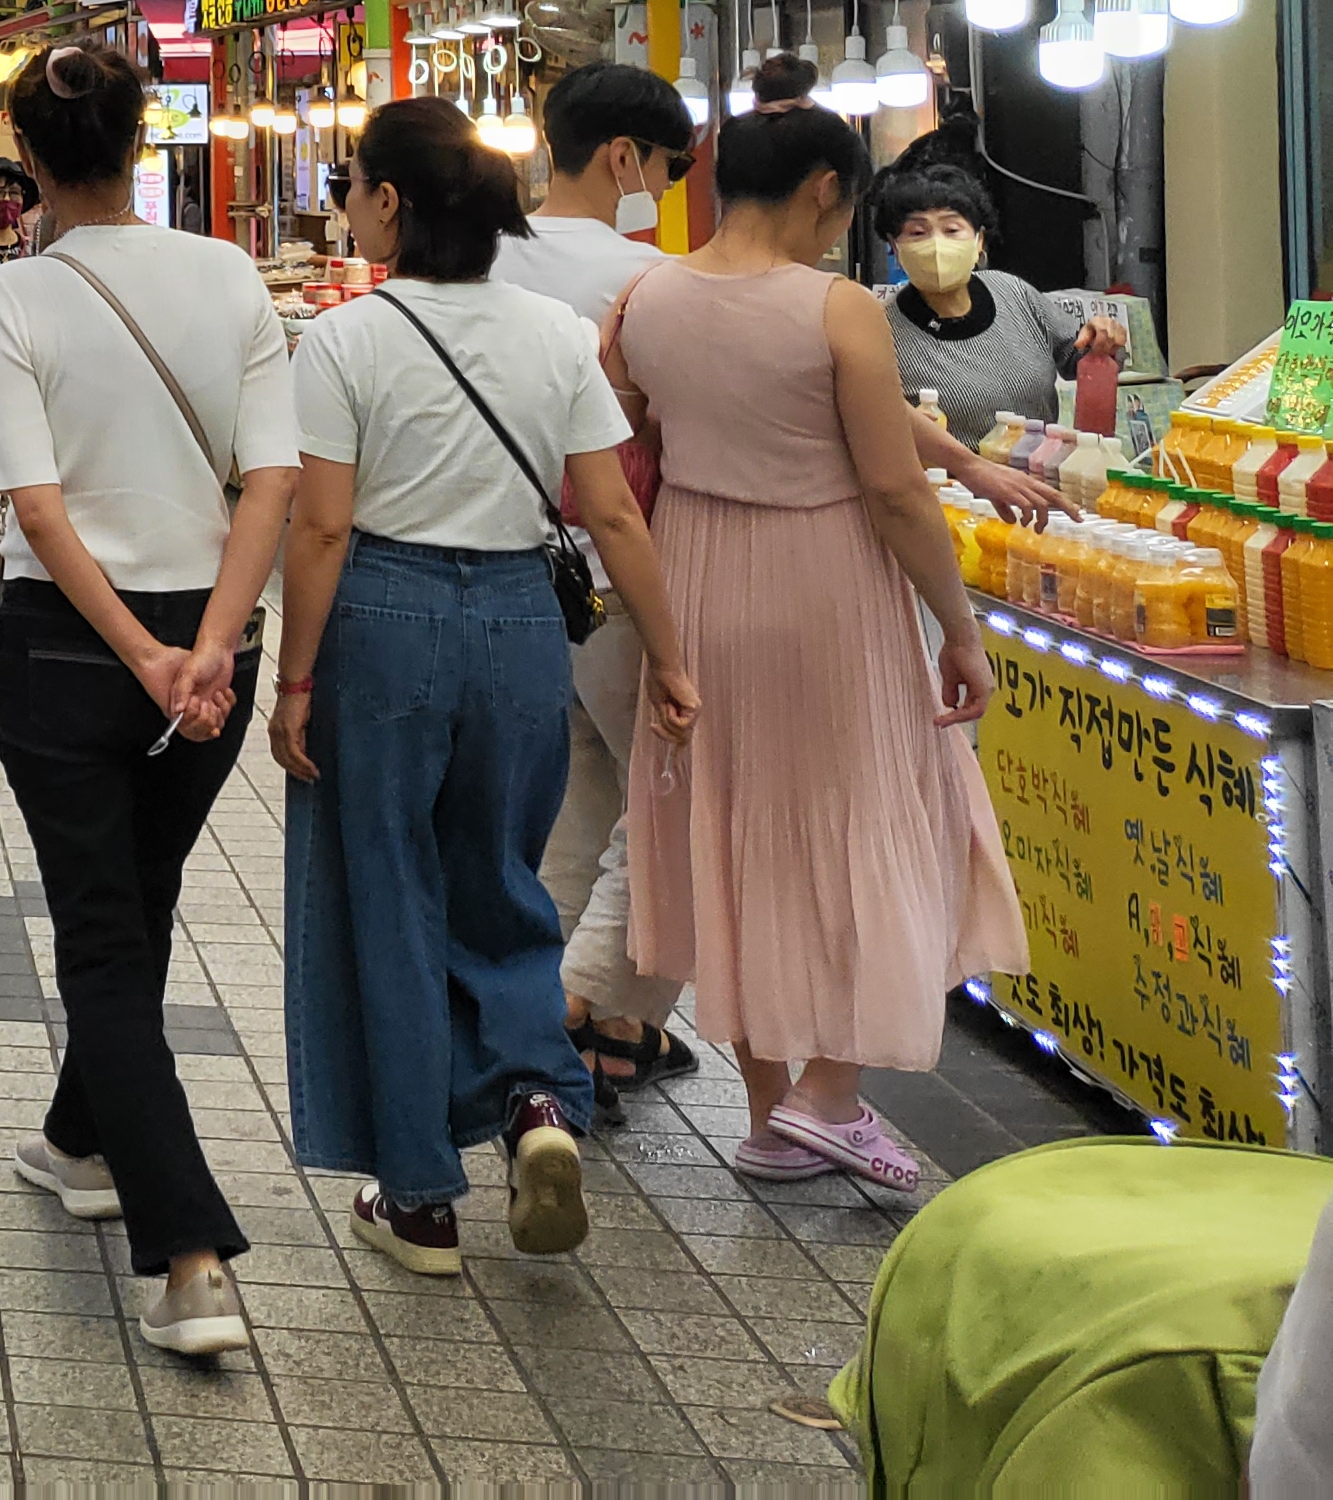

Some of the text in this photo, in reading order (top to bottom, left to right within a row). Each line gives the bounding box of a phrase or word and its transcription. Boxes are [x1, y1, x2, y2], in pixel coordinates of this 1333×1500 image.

[996, 749, 1091, 835] 단호박식혜
[1185, 740, 1257, 819] 식혜
[1002, 819, 1094, 905] 오미자식혜
[1124, 817, 1224, 907] 옛날식혜
[1015, 884, 1080, 959] 기식혜
